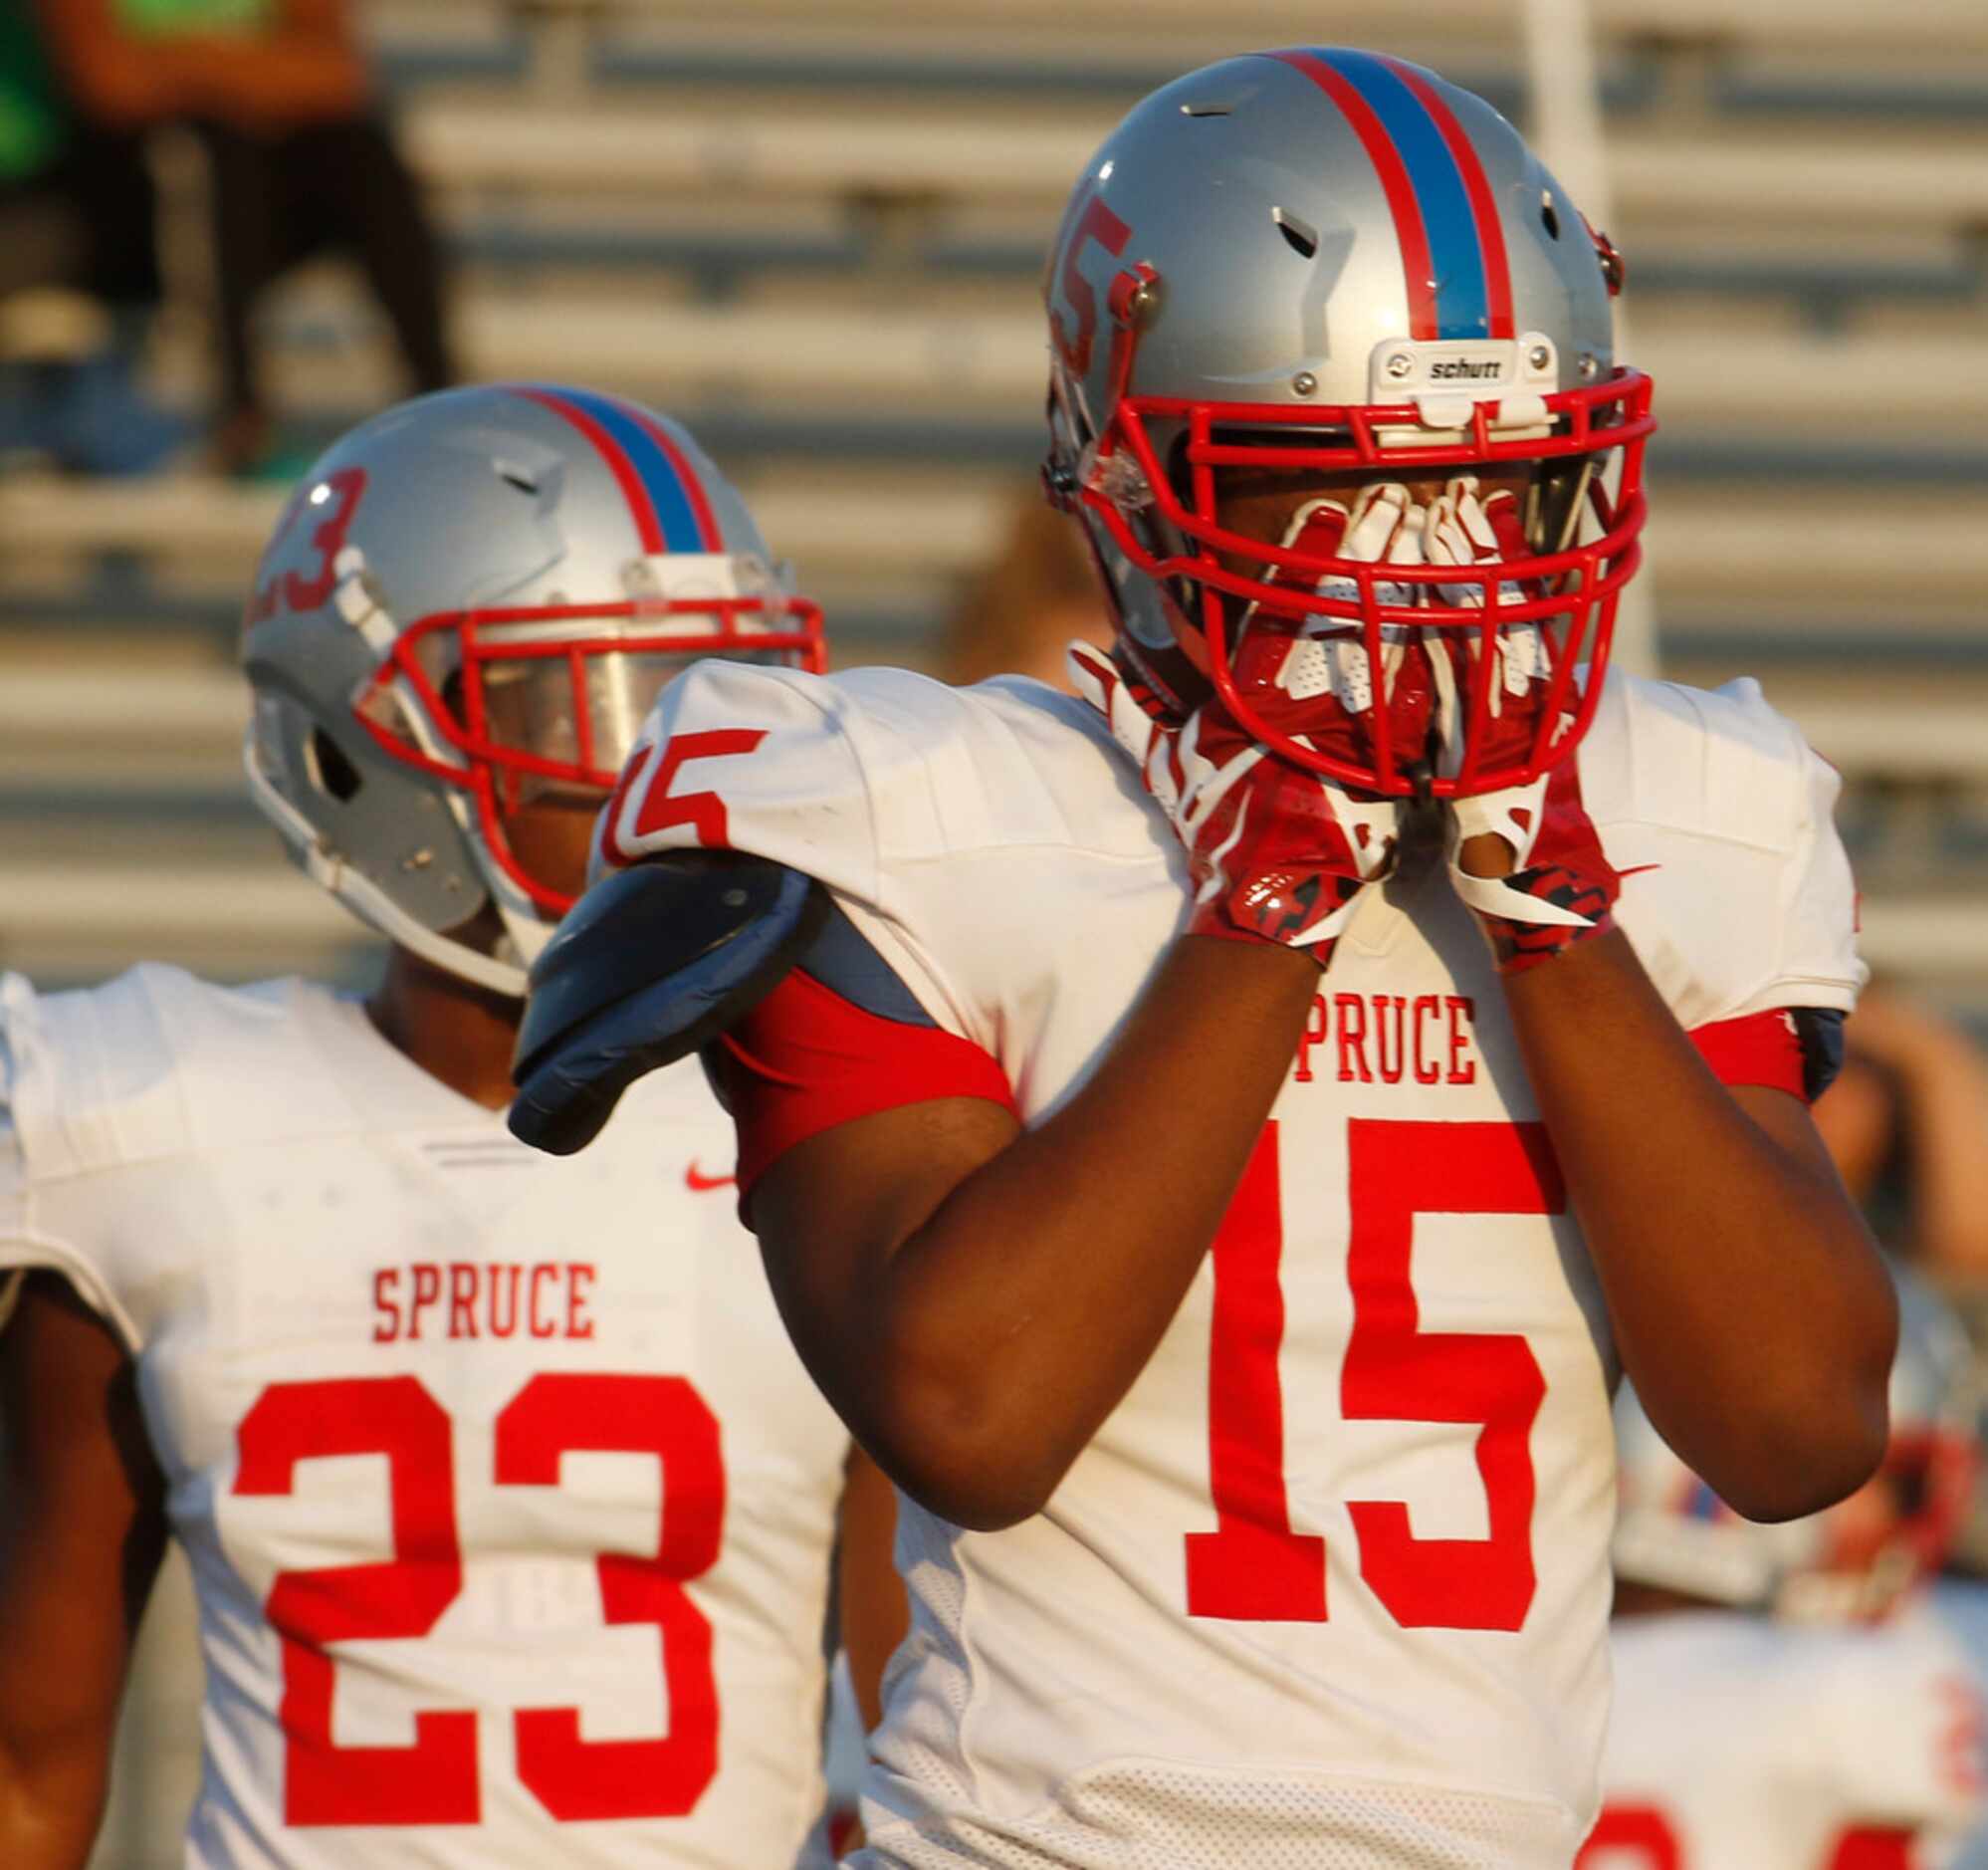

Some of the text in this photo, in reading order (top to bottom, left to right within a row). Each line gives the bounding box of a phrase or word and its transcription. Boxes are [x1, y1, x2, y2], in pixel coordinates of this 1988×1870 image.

[1431, 357, 1501, 379] schutt
[1294, 993, 1476, 1085] PRUCE
[372, 1263, 596, 1342] SPRUCE
[1185, 1117, 1567, 1632] 15
[231, 1372, 727, 1828] 23
